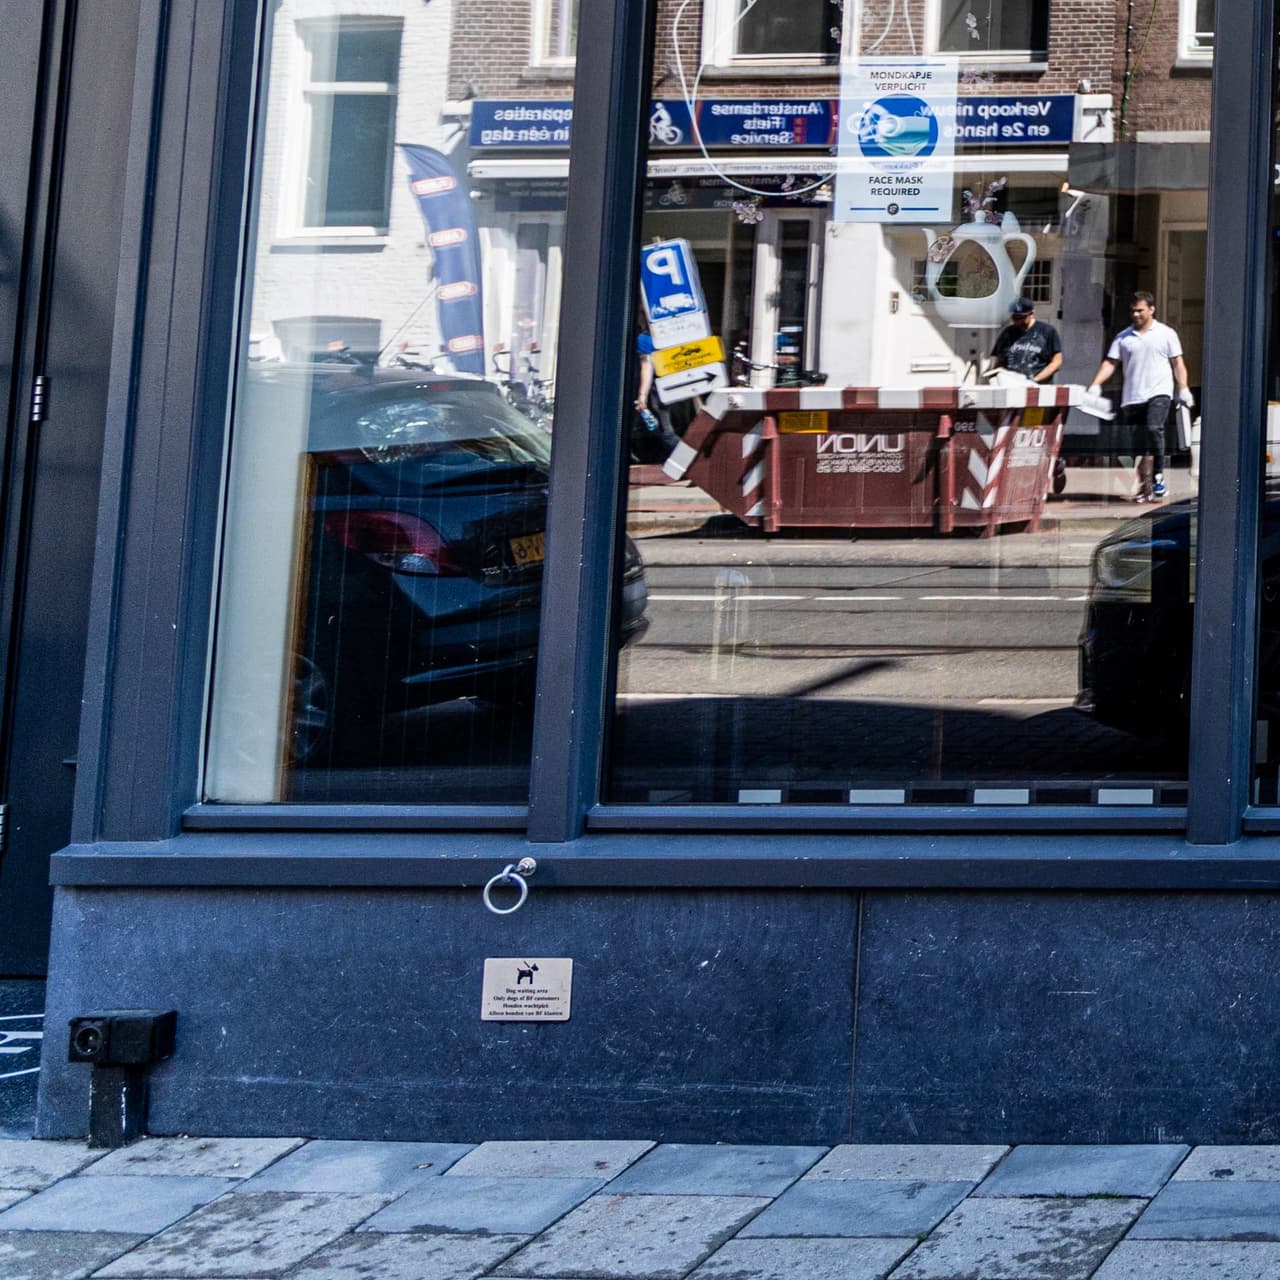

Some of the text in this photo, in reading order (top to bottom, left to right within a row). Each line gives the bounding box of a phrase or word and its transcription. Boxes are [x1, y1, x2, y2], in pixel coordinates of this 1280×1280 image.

[870, 71, 932, 80] MONDKAPJE
[875, 83, 927, 91] VERPLICHT
[869, 176, 923, 184] FACE MASK
[871, 187, 920, 196] REQUIRED
